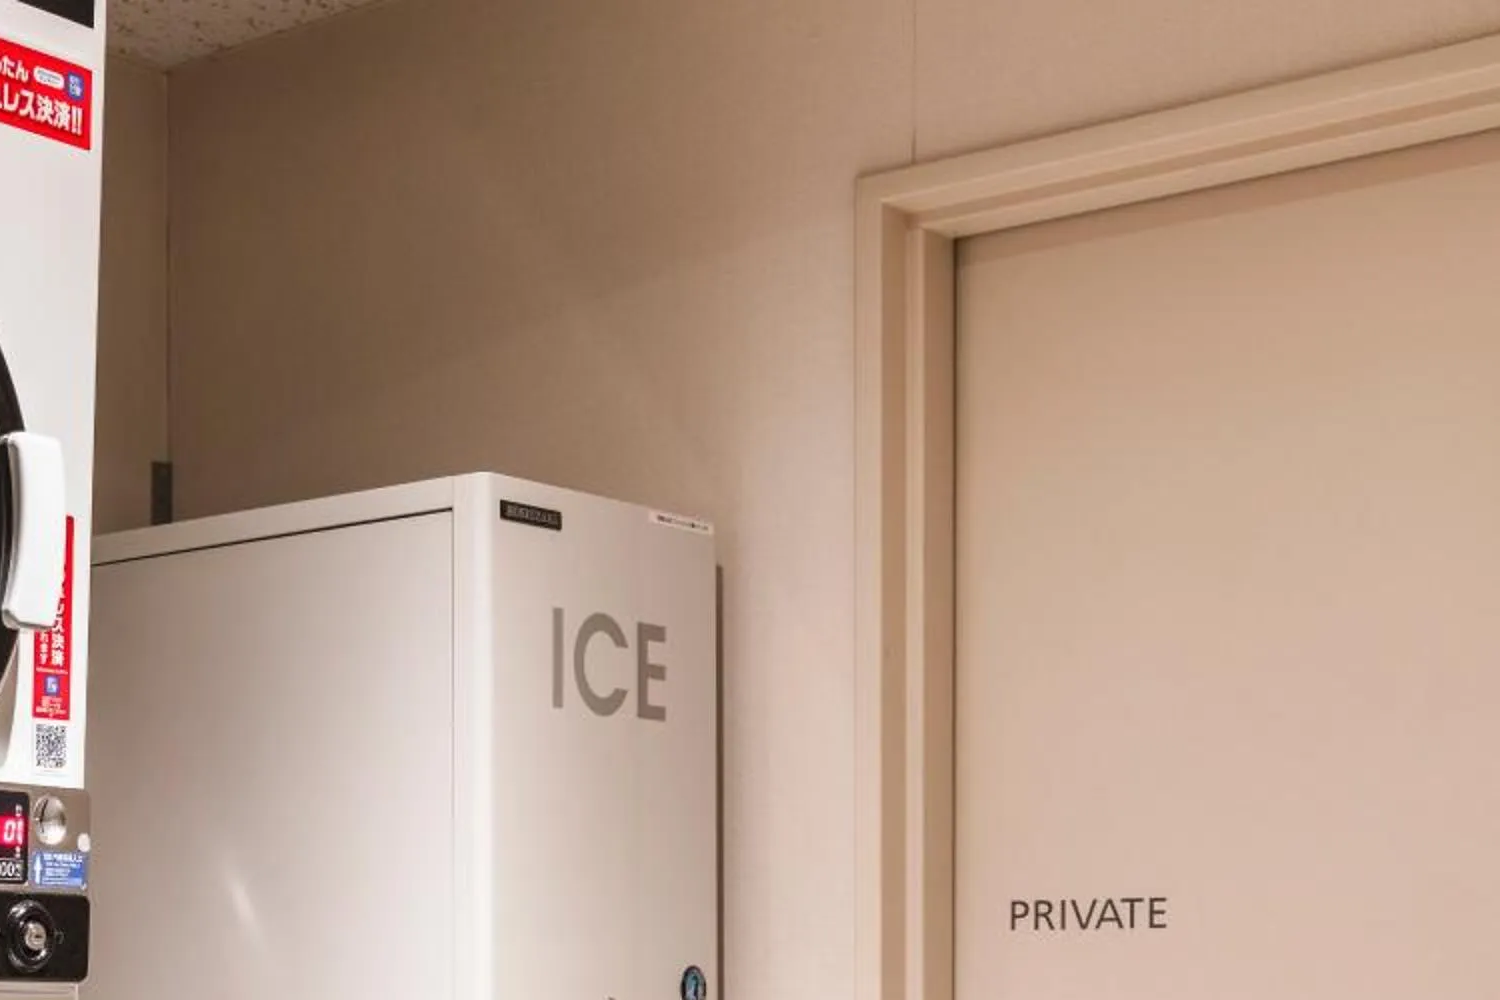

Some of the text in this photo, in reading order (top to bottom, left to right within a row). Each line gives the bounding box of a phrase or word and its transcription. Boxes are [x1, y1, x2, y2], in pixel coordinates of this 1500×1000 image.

[552, 607, 667, 722] ICE
[3, 818, 25, 845] 01
[1010, 897, 1168, 931] PRIVATE
